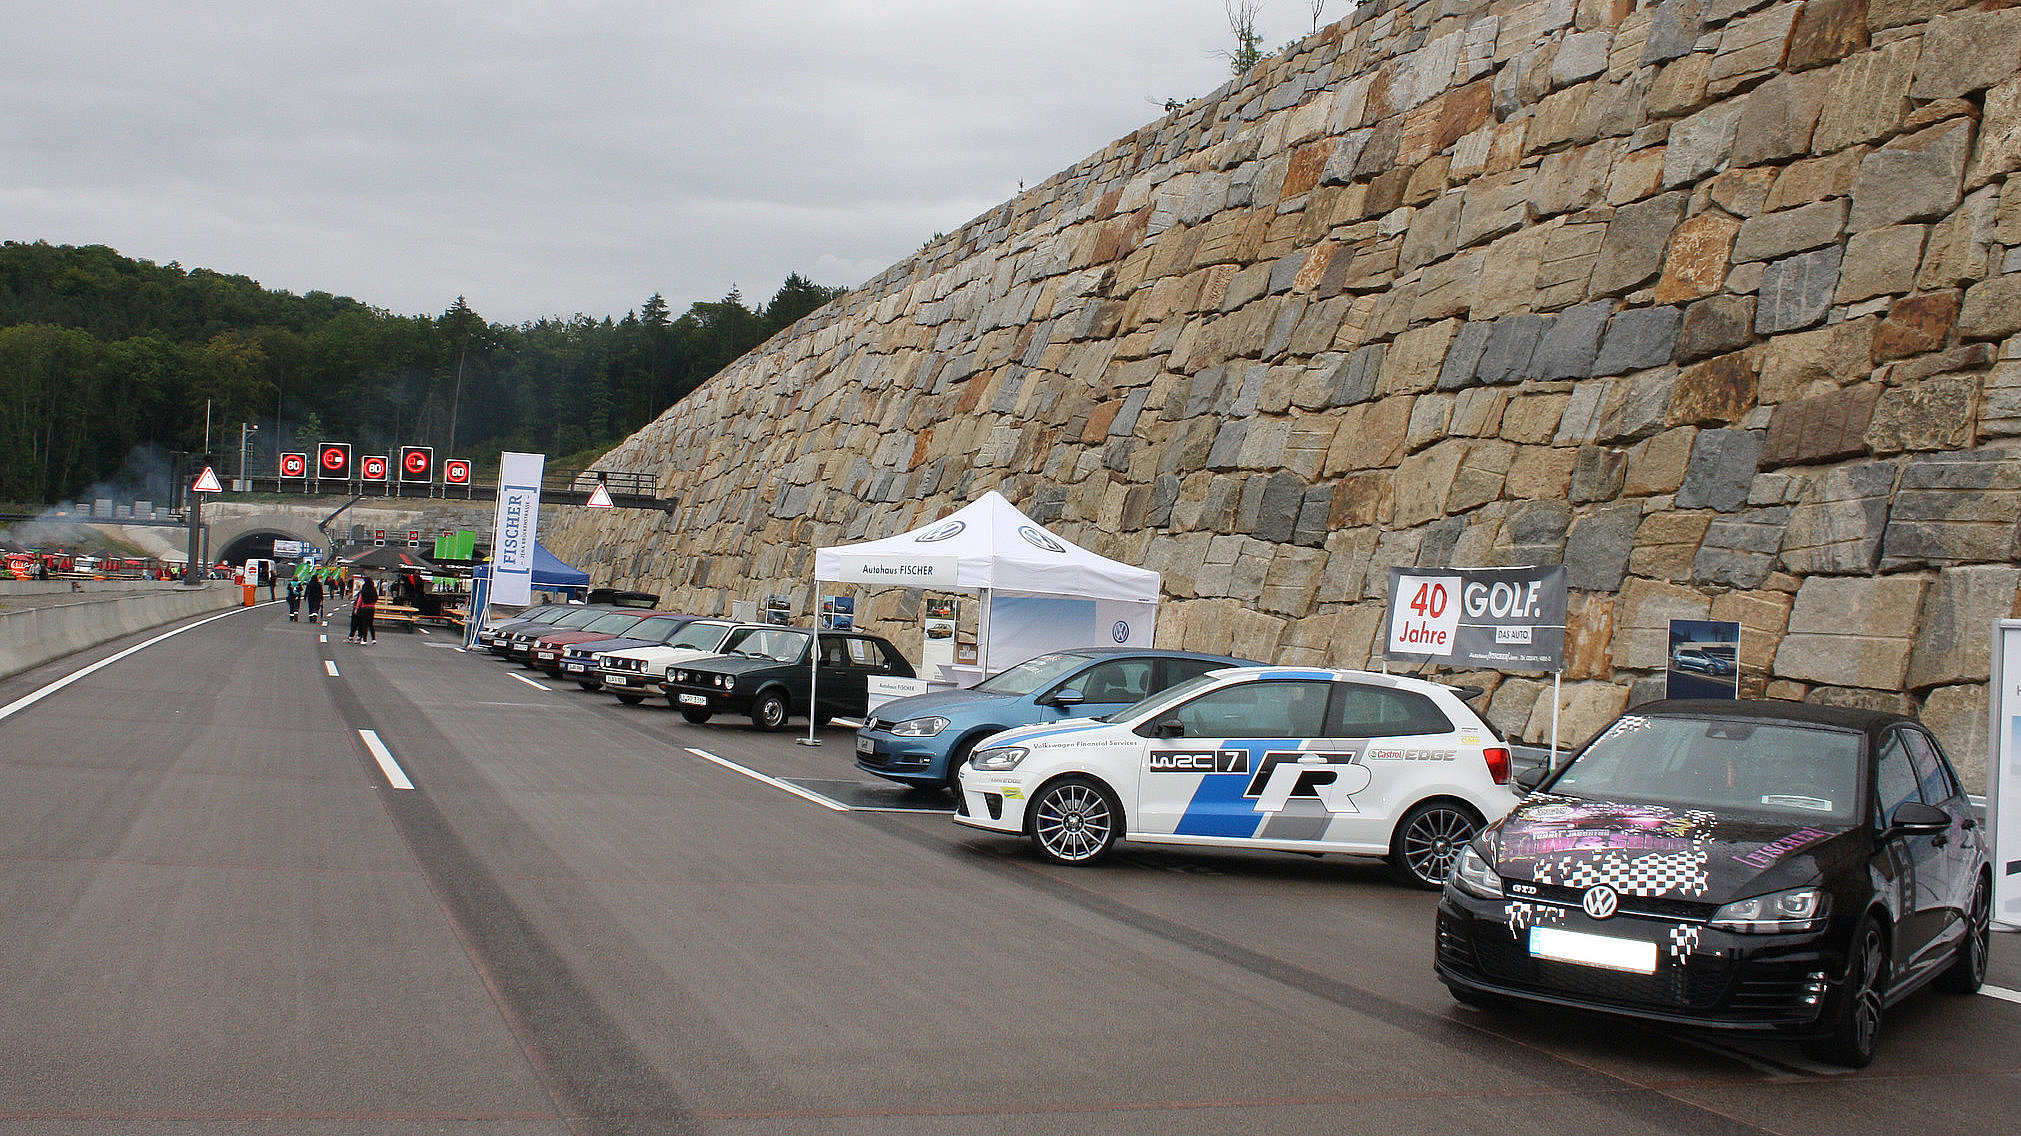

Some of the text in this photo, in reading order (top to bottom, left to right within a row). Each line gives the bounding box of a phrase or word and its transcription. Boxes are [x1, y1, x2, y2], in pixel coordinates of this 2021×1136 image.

[286, 461, 300, 470] 80
[368, 464, 382, 473] 80
[451, 468, 465, 477] 80
[503, 494, 523, 565] FISCHER
[862, 564, 934, 576] Autohaus FISCHER
[1410, 582, 1448, 619] 40
[1463, 580, 1542, 618] GOLF.
[1399, 621, 1447, 645] Jahre
[1497, 630, 1510, 639] DAS
[1033, 742, 1075, 750] Volkswagen
[1377, 749, 1457, 761] Castrol EDGE
[1150, 751, 1241, 772] WRC 7
[1512, 884, 1537, 894] GTD
